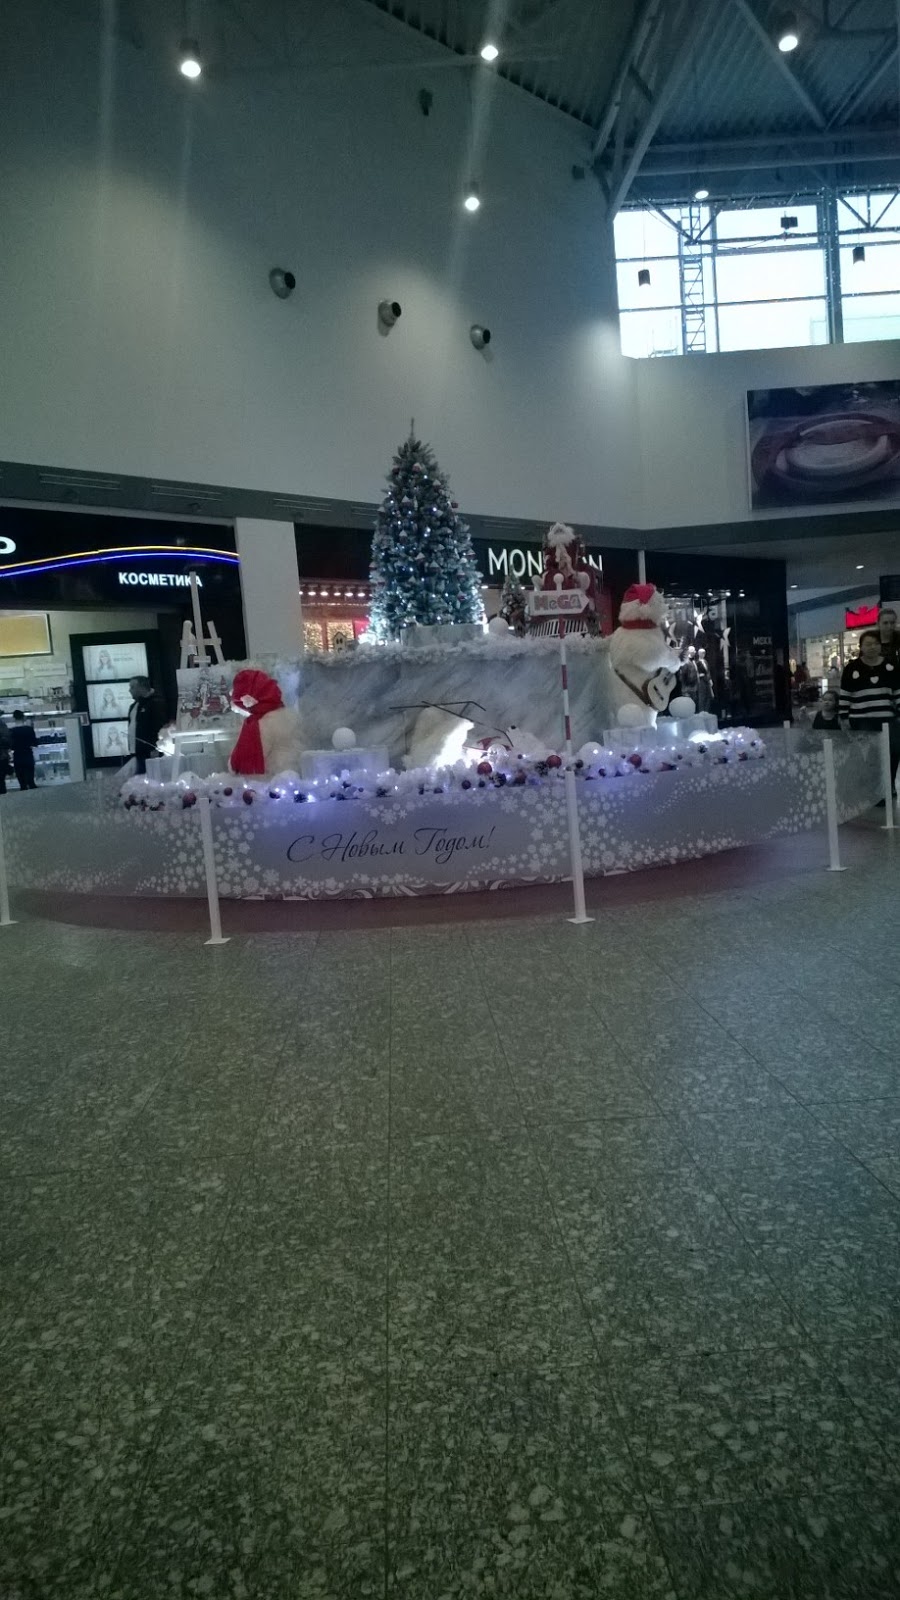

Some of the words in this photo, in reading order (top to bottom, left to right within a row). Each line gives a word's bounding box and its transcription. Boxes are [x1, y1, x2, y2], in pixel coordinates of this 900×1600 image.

[118, 572, 202, 587] КОСМЕТИКА
[286, 834, 316, 863] С
[322, 829, 404, 862] Новым
[413, 826, 495, 865] Годом!
